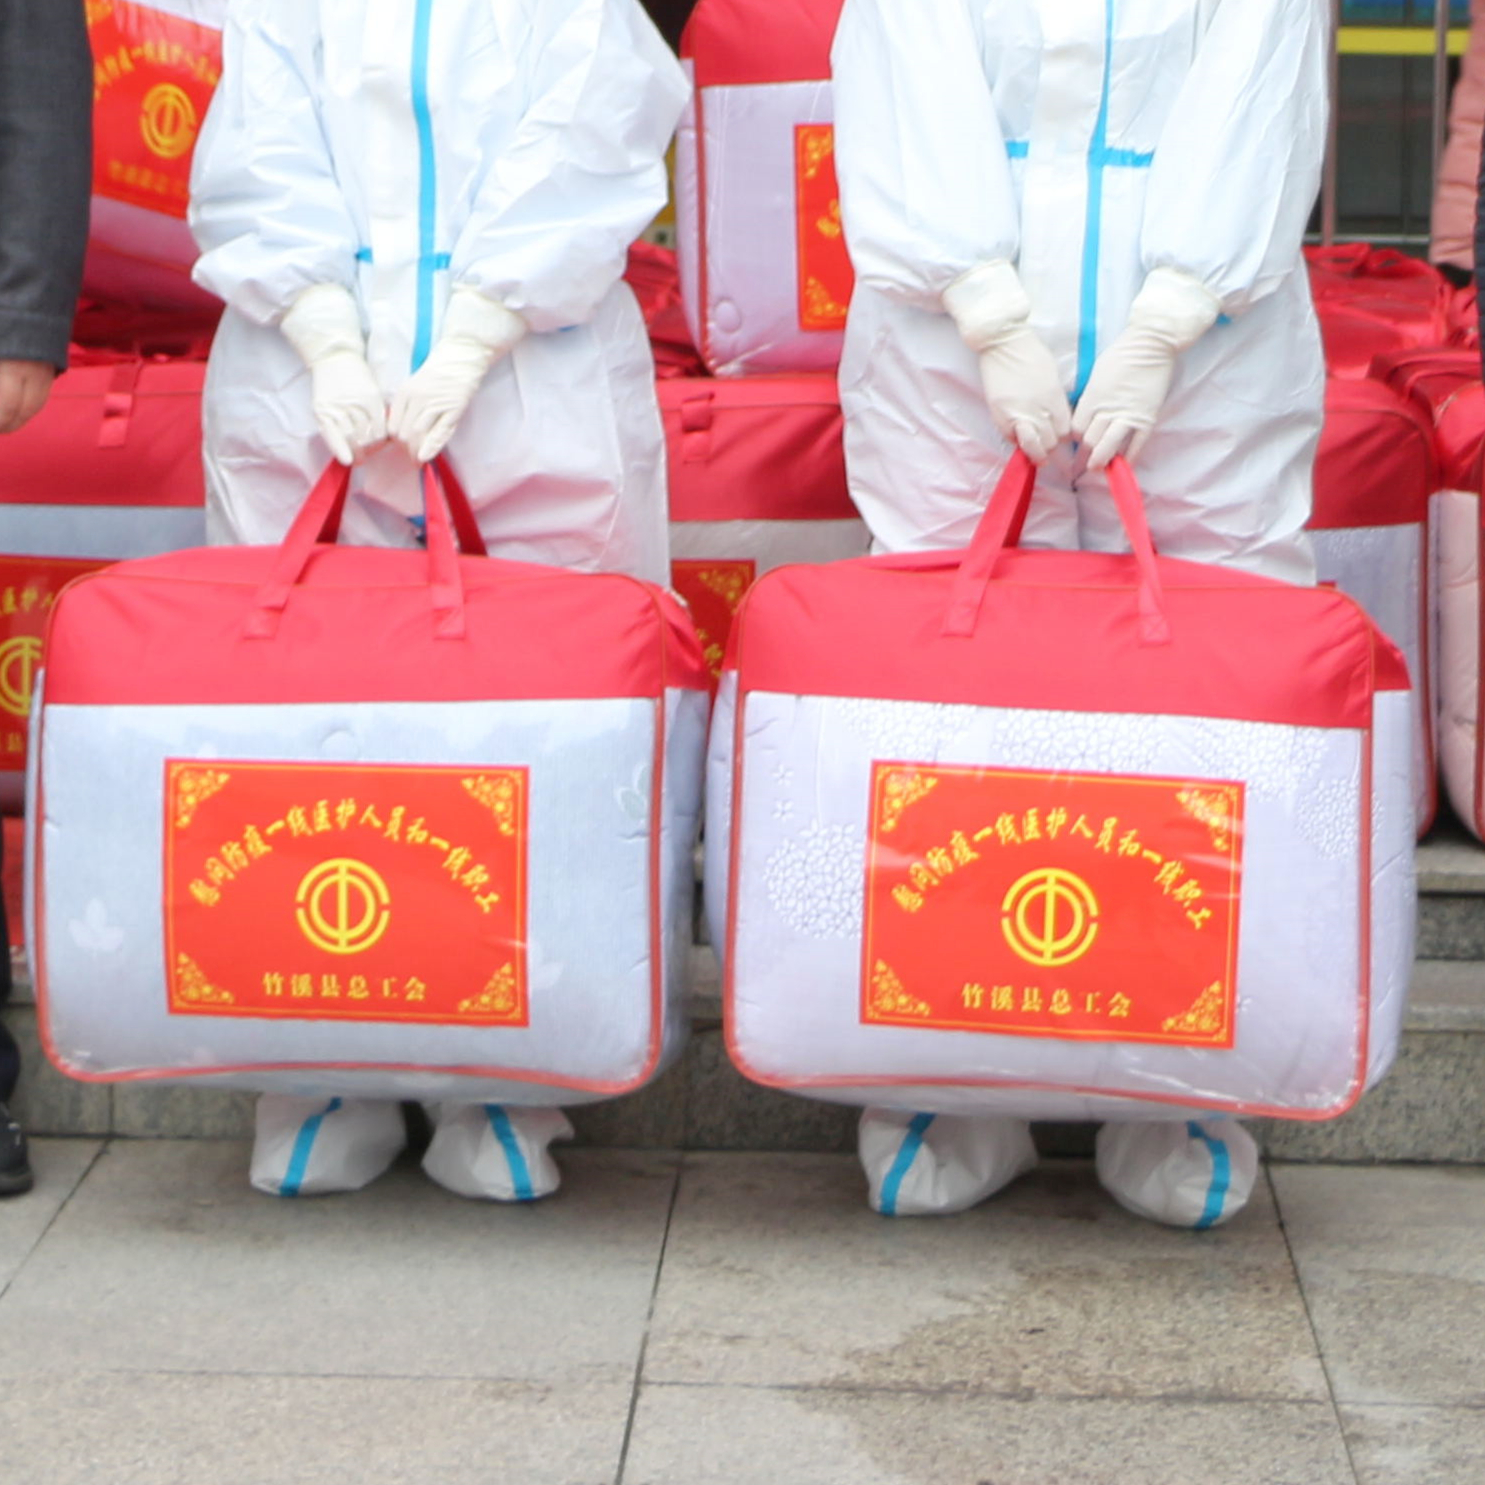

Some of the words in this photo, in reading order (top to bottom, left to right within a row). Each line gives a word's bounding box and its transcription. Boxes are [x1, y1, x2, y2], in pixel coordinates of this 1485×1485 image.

[262, 971, 426, 1001] 竹溪县总工会
[961, 982, 1132, 1018] 竹溪县总工会
